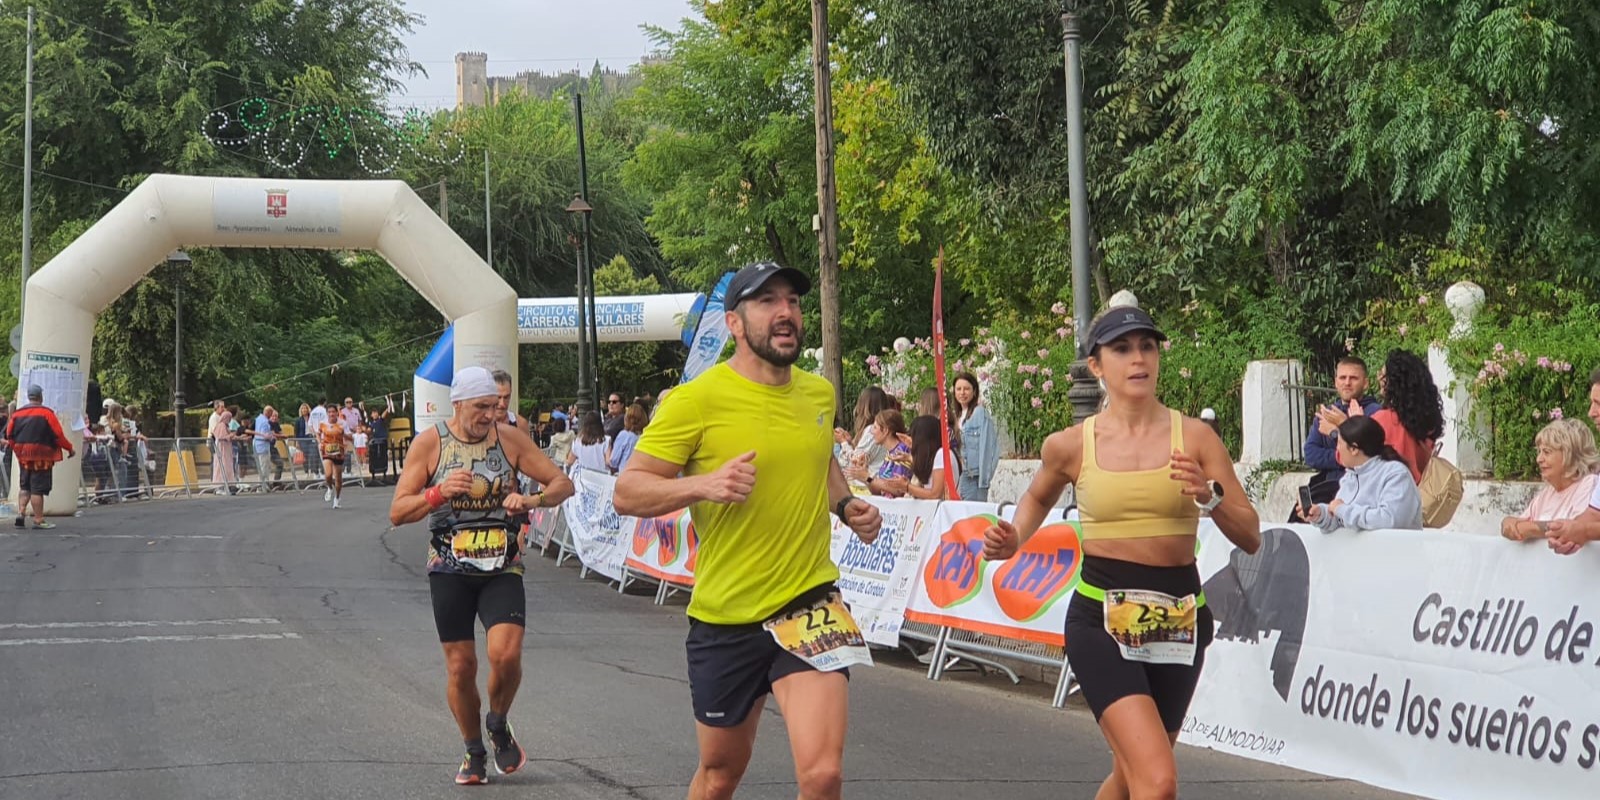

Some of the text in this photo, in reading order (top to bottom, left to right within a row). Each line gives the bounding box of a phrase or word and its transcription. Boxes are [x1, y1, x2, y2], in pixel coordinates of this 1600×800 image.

[517, 306, 564, 316] CIRCUITO
[631, 303, 645, 312] DE
[517, 315, 576, 327] CARRERAS
[452, 500, 498, 510] WOMAN
[469, 528, 490, 544] 77
[838, 541, 898, 574] populares
[934, 539, 1075, 600] KH7 KH7
[797, 606, 837, 631] 22
[1137, 604, 1169, 623] 23
[1412, 592, 1594, 664] Castillo de
[1300, 664, 1391, 729] donde
[1395, 678, 1442, 740] los
[1447, 695, 1572, 764] sueños
[1195, 722, 1210, 734] DE
[1206, 723, 1286, 756] ALMODÓVAR
